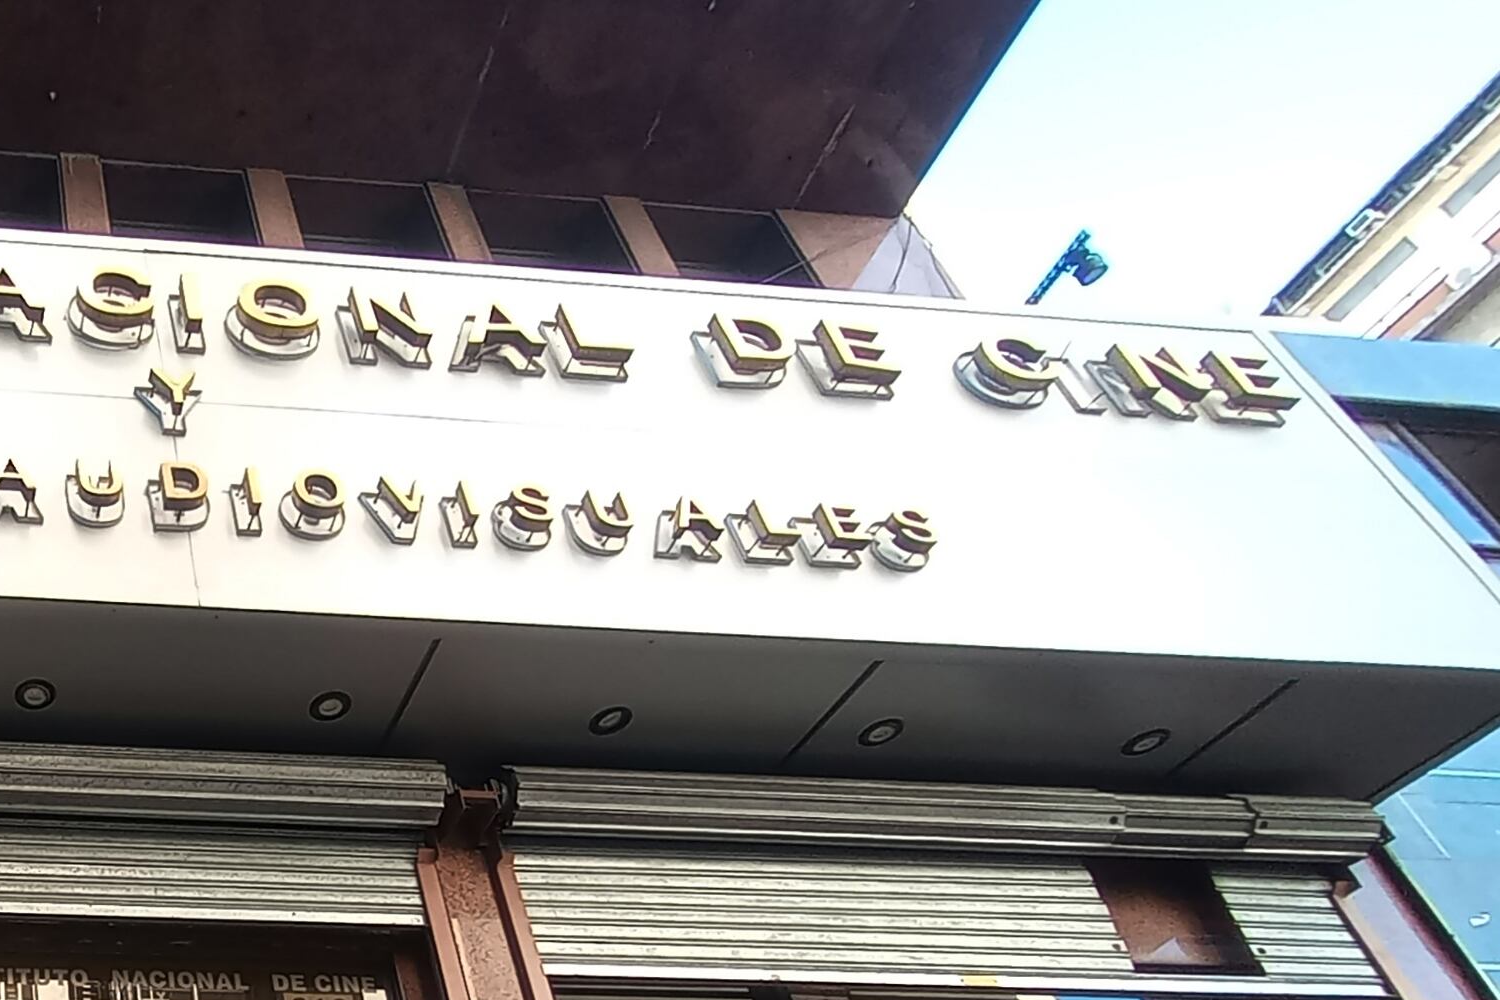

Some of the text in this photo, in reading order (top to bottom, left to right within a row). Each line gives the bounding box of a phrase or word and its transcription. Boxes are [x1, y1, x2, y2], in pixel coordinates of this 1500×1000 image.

[133, 368, 202, 436] Y
[688, 313, 902, 402] DE
[952, 335, 1300, 428] CINE
[111, 969, 250, 992] NACIONAL
[271, 973, 306, 992] DE
[313, 975, 378, 994] CINE
